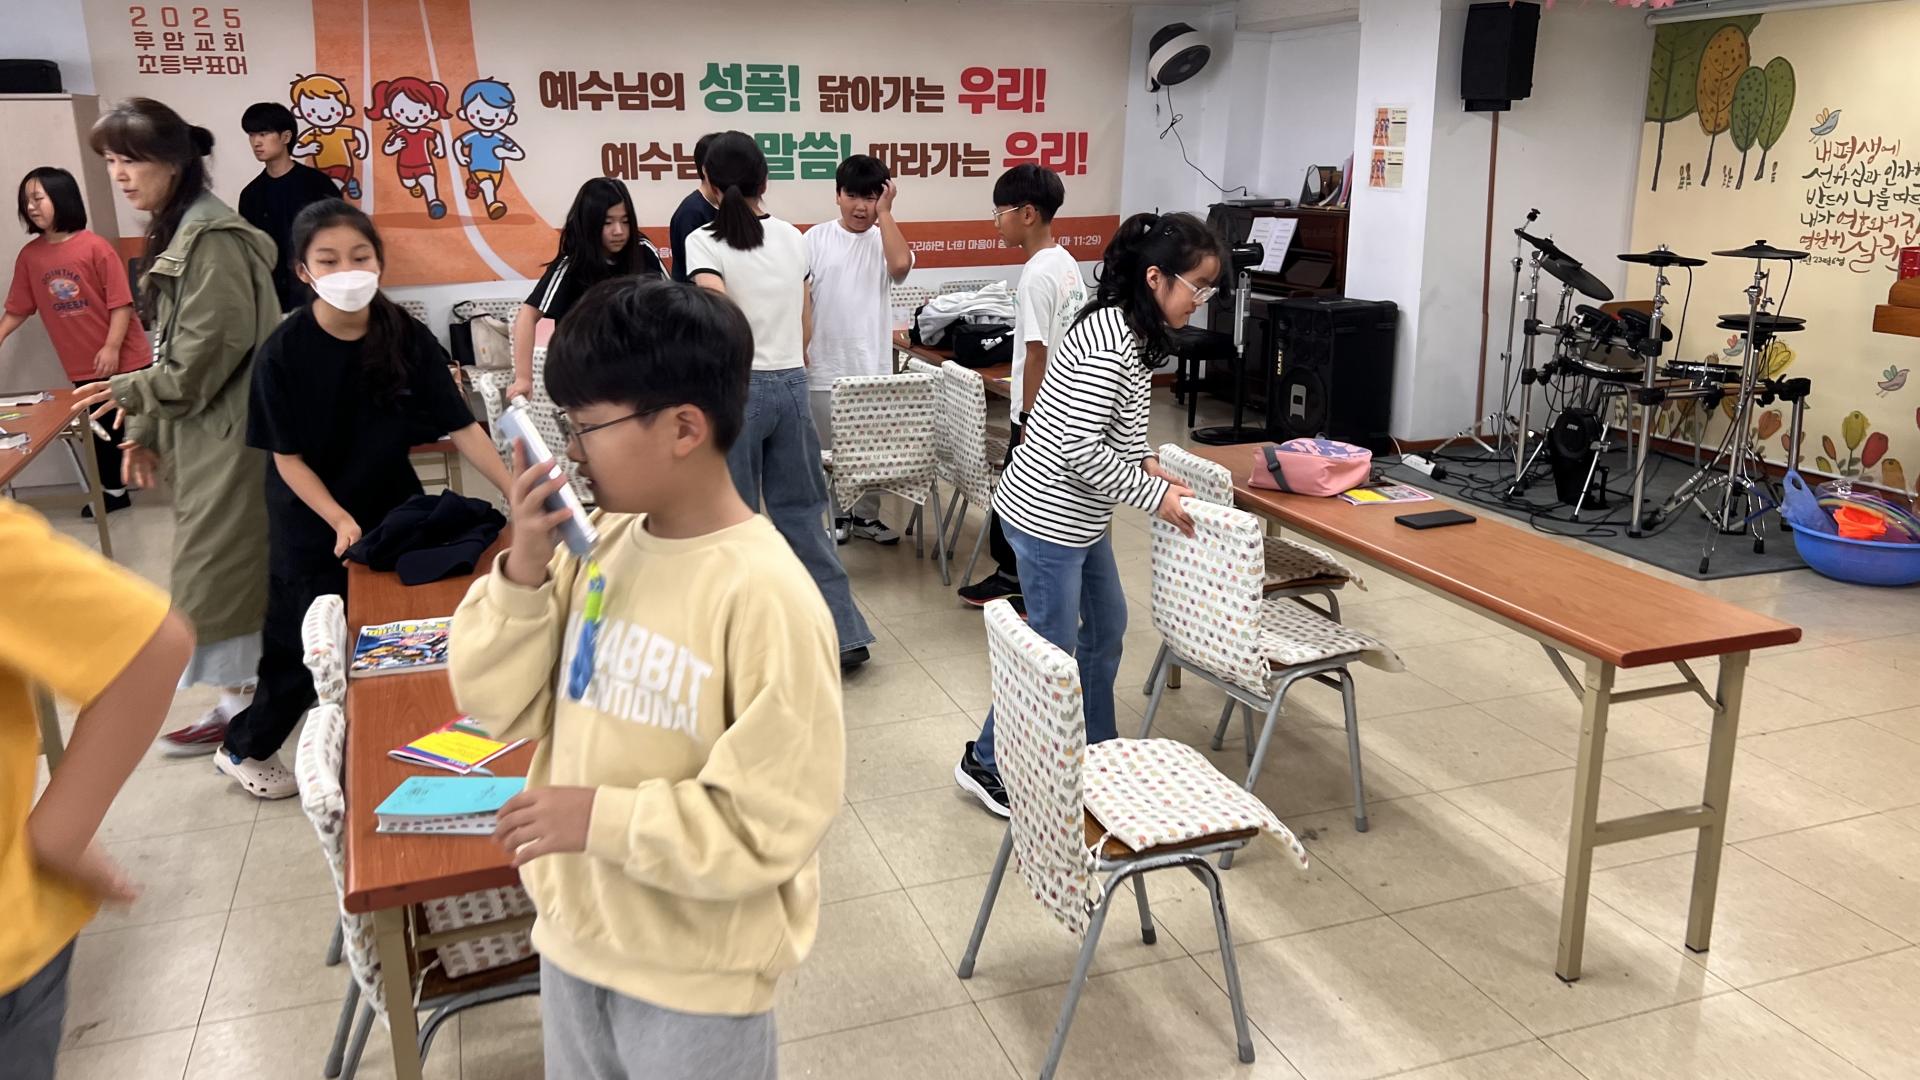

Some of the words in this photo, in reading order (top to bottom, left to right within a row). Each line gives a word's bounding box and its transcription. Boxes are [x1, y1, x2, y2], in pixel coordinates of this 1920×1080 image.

[129, 6, 241, 28] 2025
[539, 70, 686, 111] 예수님의
[699, 62, 801, 113] 성품!
[818, 75, 946, 113] 닮아가는
[958, 66, 1047, 115] 우리!
[1003, 131, 1089, 176] 우리!
[1806, 186, 1849, 208] 반드시
[1853, 188, 1891, 212] 나를
[1800, 210, 1836, 228] 내가
[946, 240, 966, 251] 너희
[968, 238, 996, 250] 마음이
[1799, 229, 1845, 250] 영원히
